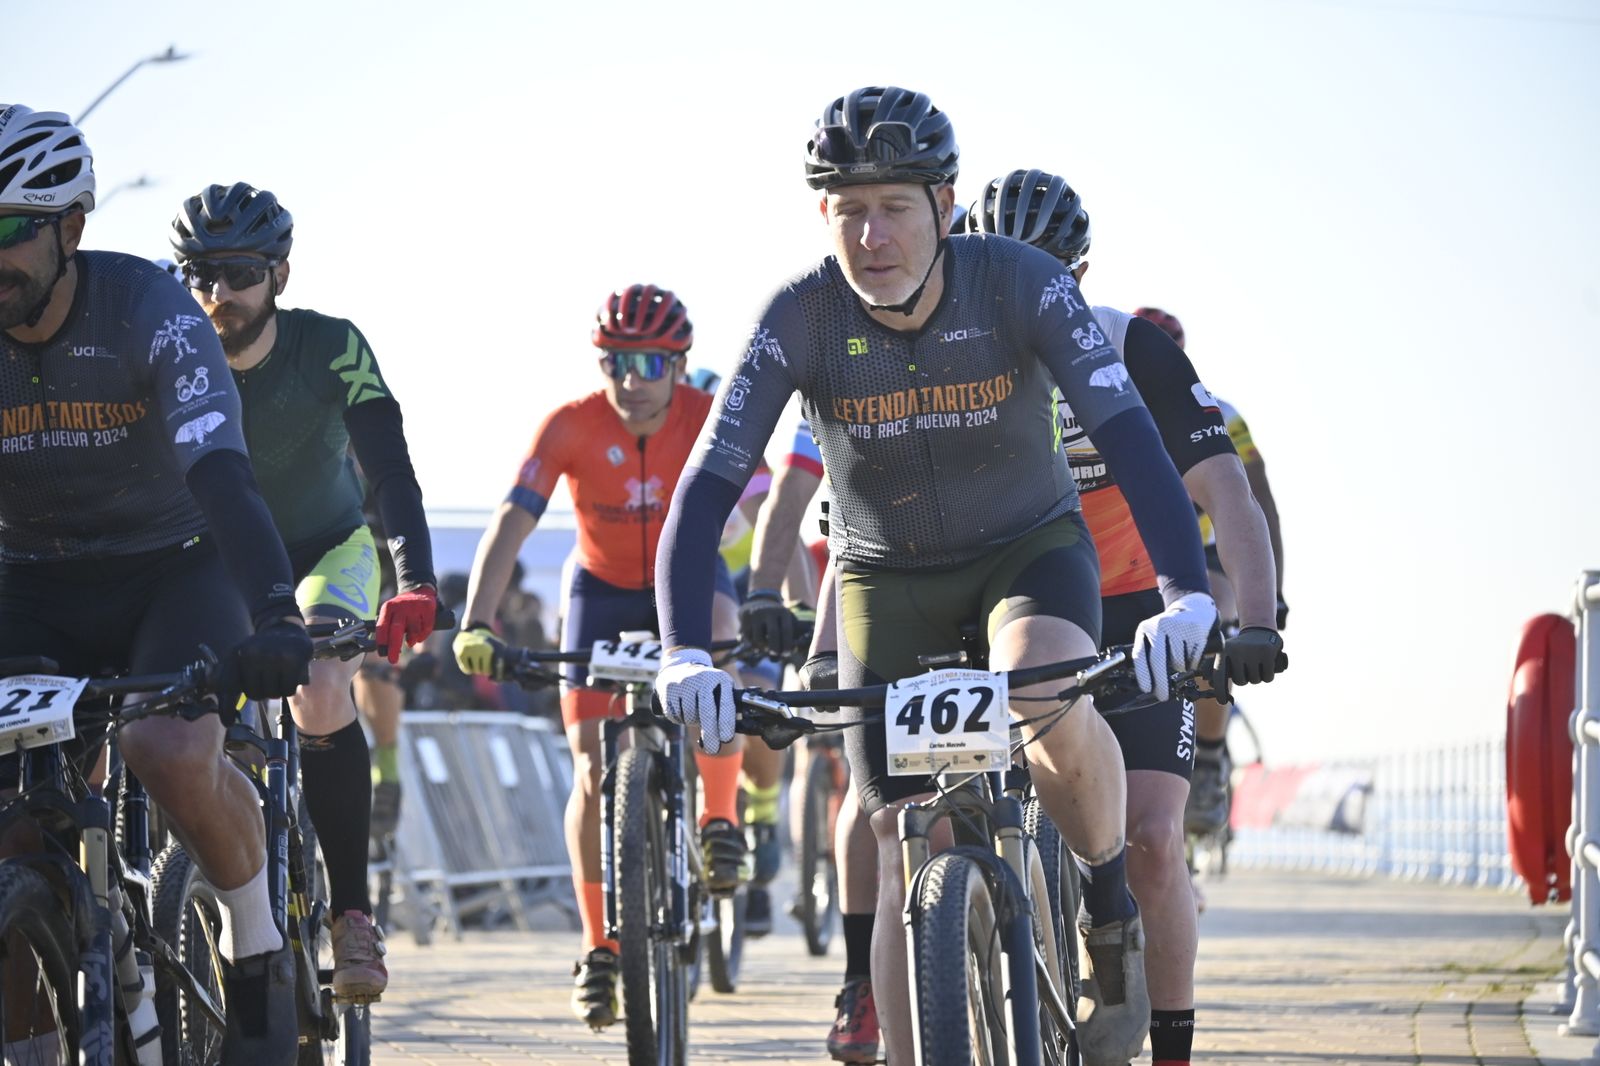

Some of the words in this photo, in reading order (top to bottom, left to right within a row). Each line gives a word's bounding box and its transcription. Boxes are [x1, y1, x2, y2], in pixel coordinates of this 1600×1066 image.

[944, 329, 968, 342] UCI
[73, 346, 95, 357] UCI
[832, 388, 919, 424] LEYENDA
[920, 371, 1013, 411] TARTESSOS
[0, 402, 45, 437] NDA
[47, 400, 146, 429] TARTESSOS
[718, 414, 740, 427] UELVA
[848, 423, 871, 439] MTB
[878, 418, 909, 439] RACE
[916, 413, 960, 430] HUELVA
[965, 406, 998, 428] 2024
[2, 433, 35, 454] RACE
[42, 429, 89, 448] HUELVA
[93, 426, 128, 447] 2024
[0, 689, 61, 718] 21
[896, 686, 994, 735] 462
